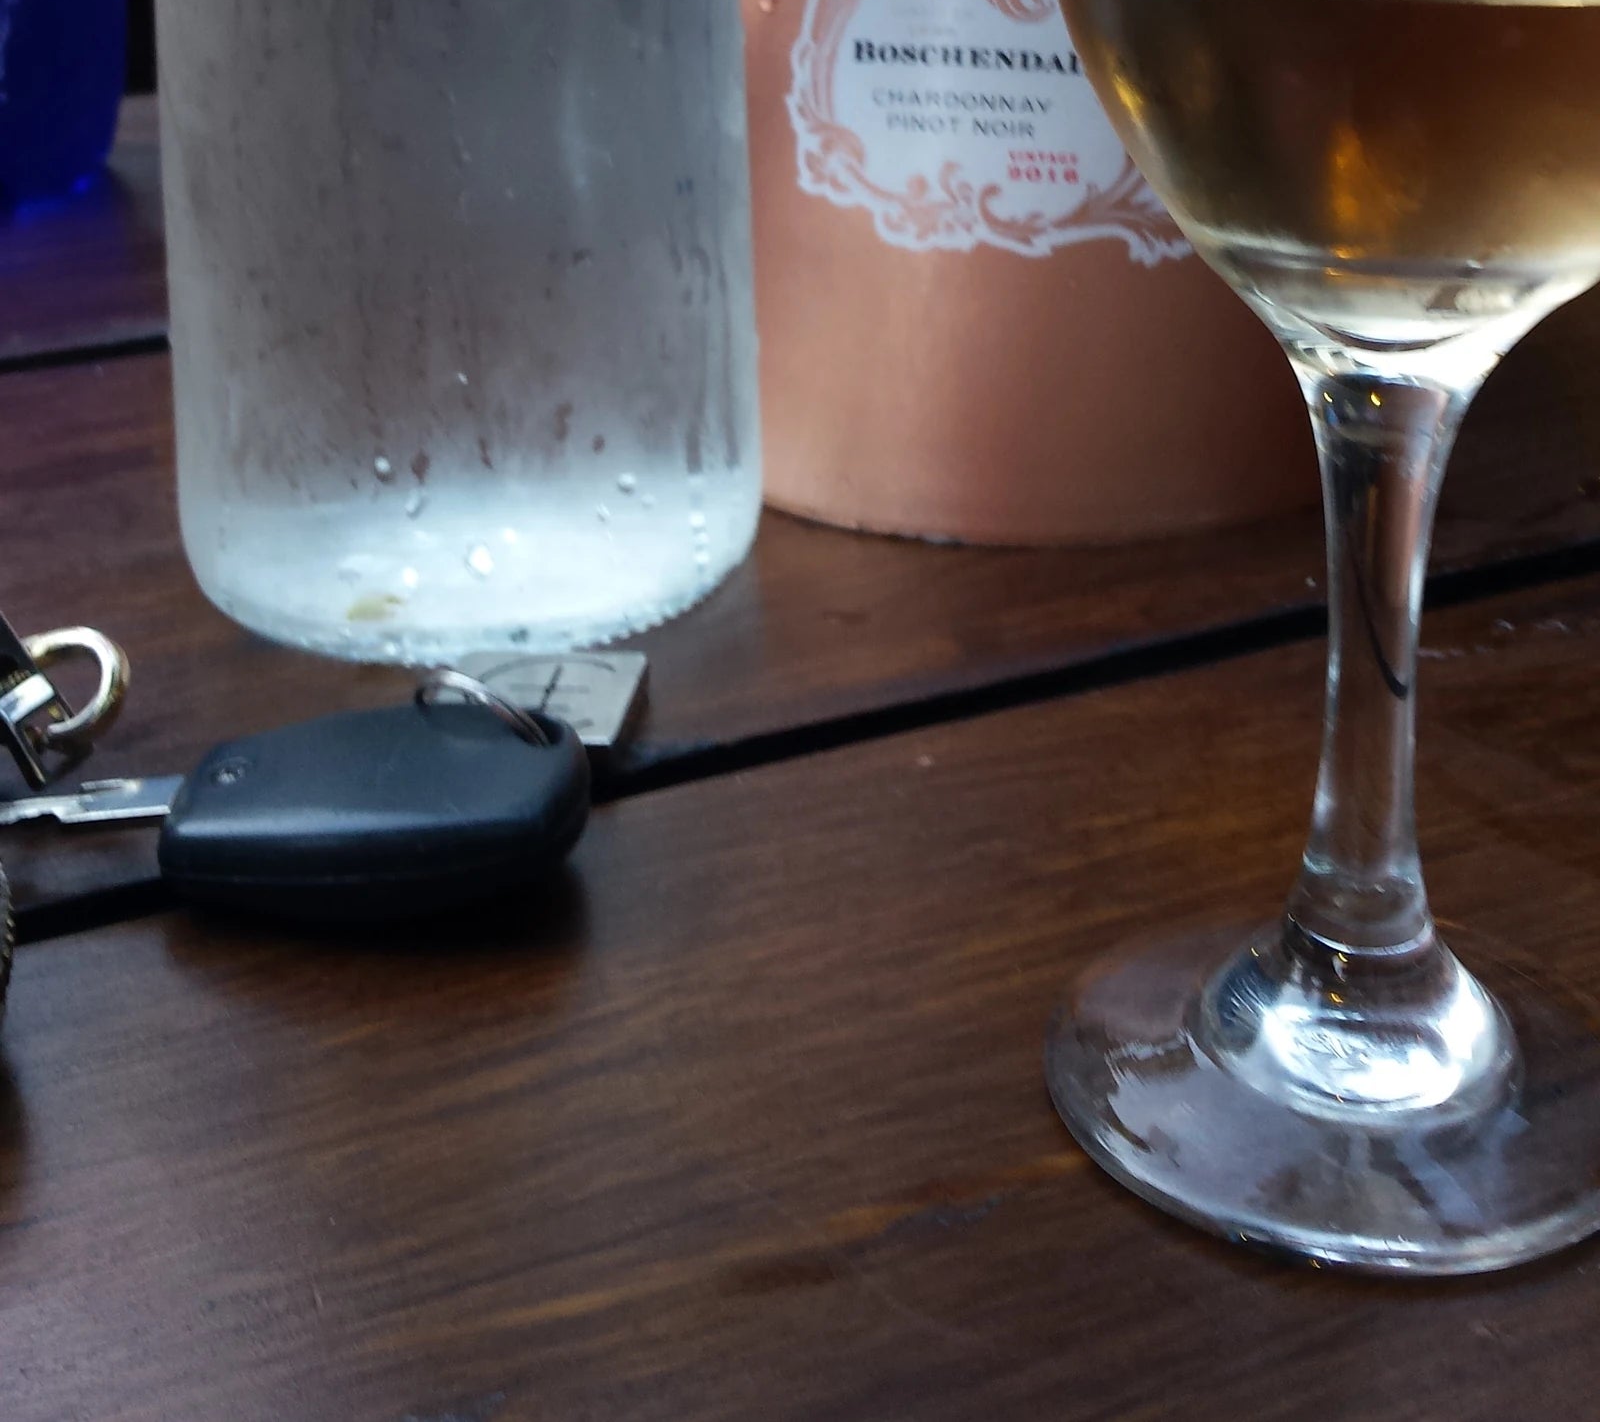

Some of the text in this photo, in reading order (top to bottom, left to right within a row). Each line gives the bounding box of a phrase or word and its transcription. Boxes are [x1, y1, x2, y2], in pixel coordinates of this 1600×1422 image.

[872, 88, 1052, 114] CHARDONNAY
[887, 113, 1036, 139] PINOT NOIR
